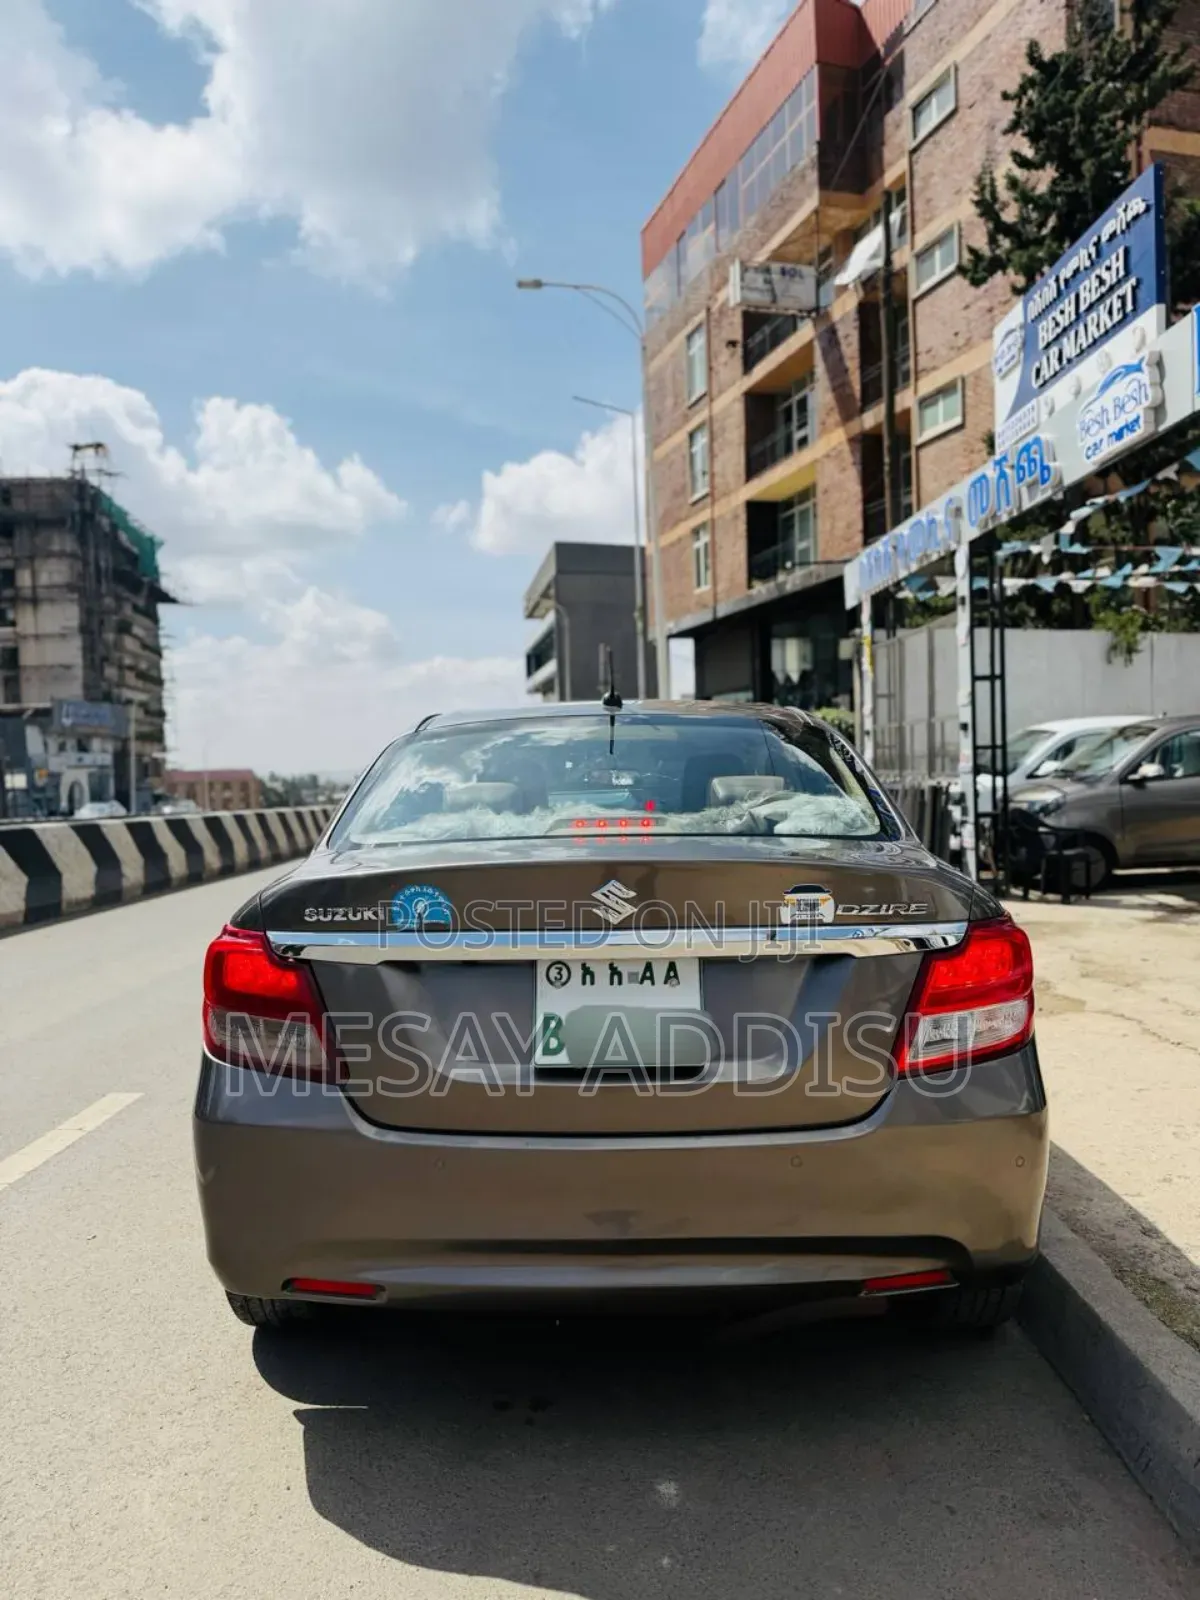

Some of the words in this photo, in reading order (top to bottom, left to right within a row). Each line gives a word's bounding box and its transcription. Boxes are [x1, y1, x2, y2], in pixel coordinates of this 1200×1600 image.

[1038, 301, 1079, 350] BESH
[1079, 245, 1126, 310] BESH
[1031, 346, 1063, 388] CAR
[1062, 276, 1137, 362] MARKET
[1112, 379, 1150, 422] Besh
[1084, 437, 1106, 461] car
[303, 906, 386, 922] SUZUKI
[836, 903, 929, 916] DZIRE
